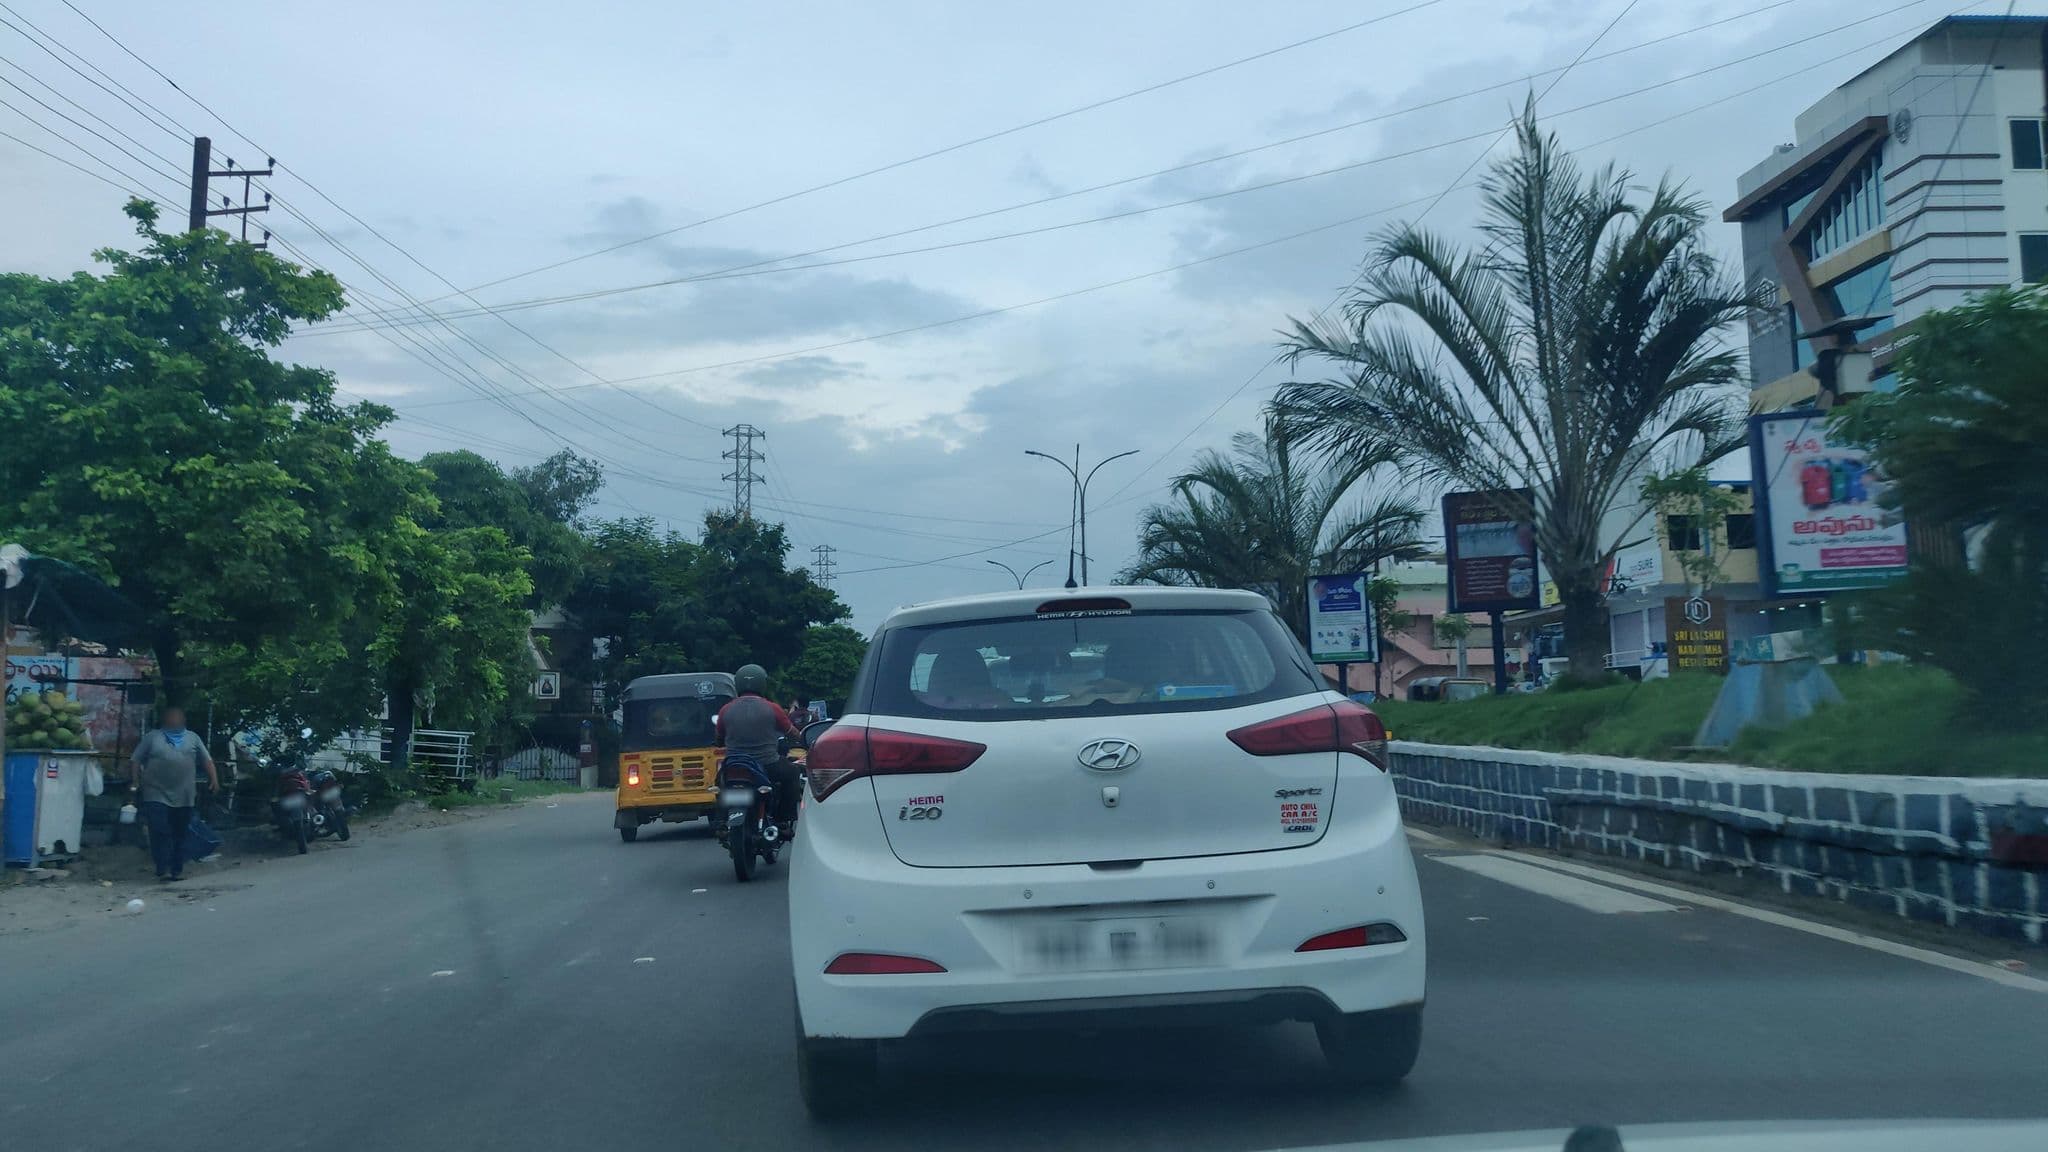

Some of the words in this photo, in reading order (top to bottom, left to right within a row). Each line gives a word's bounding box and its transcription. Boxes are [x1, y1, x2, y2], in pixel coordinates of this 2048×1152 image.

[1088, 609, 1132, 617] HYUNDAI
[1675, 630, 1688, 641] SRI
[1678, 644, 1722, 655] NARAMHA
[1679, 657, 1722, 667] RESIENCY
[1274, 788, 1322, 799] Sportz
[909, 795, 944, 805] HEMA
[1281, 803, 1298, 811] AUTO
[1300, 803, 1317, 811] CHILL
[899, 806, 943, 820] i20
